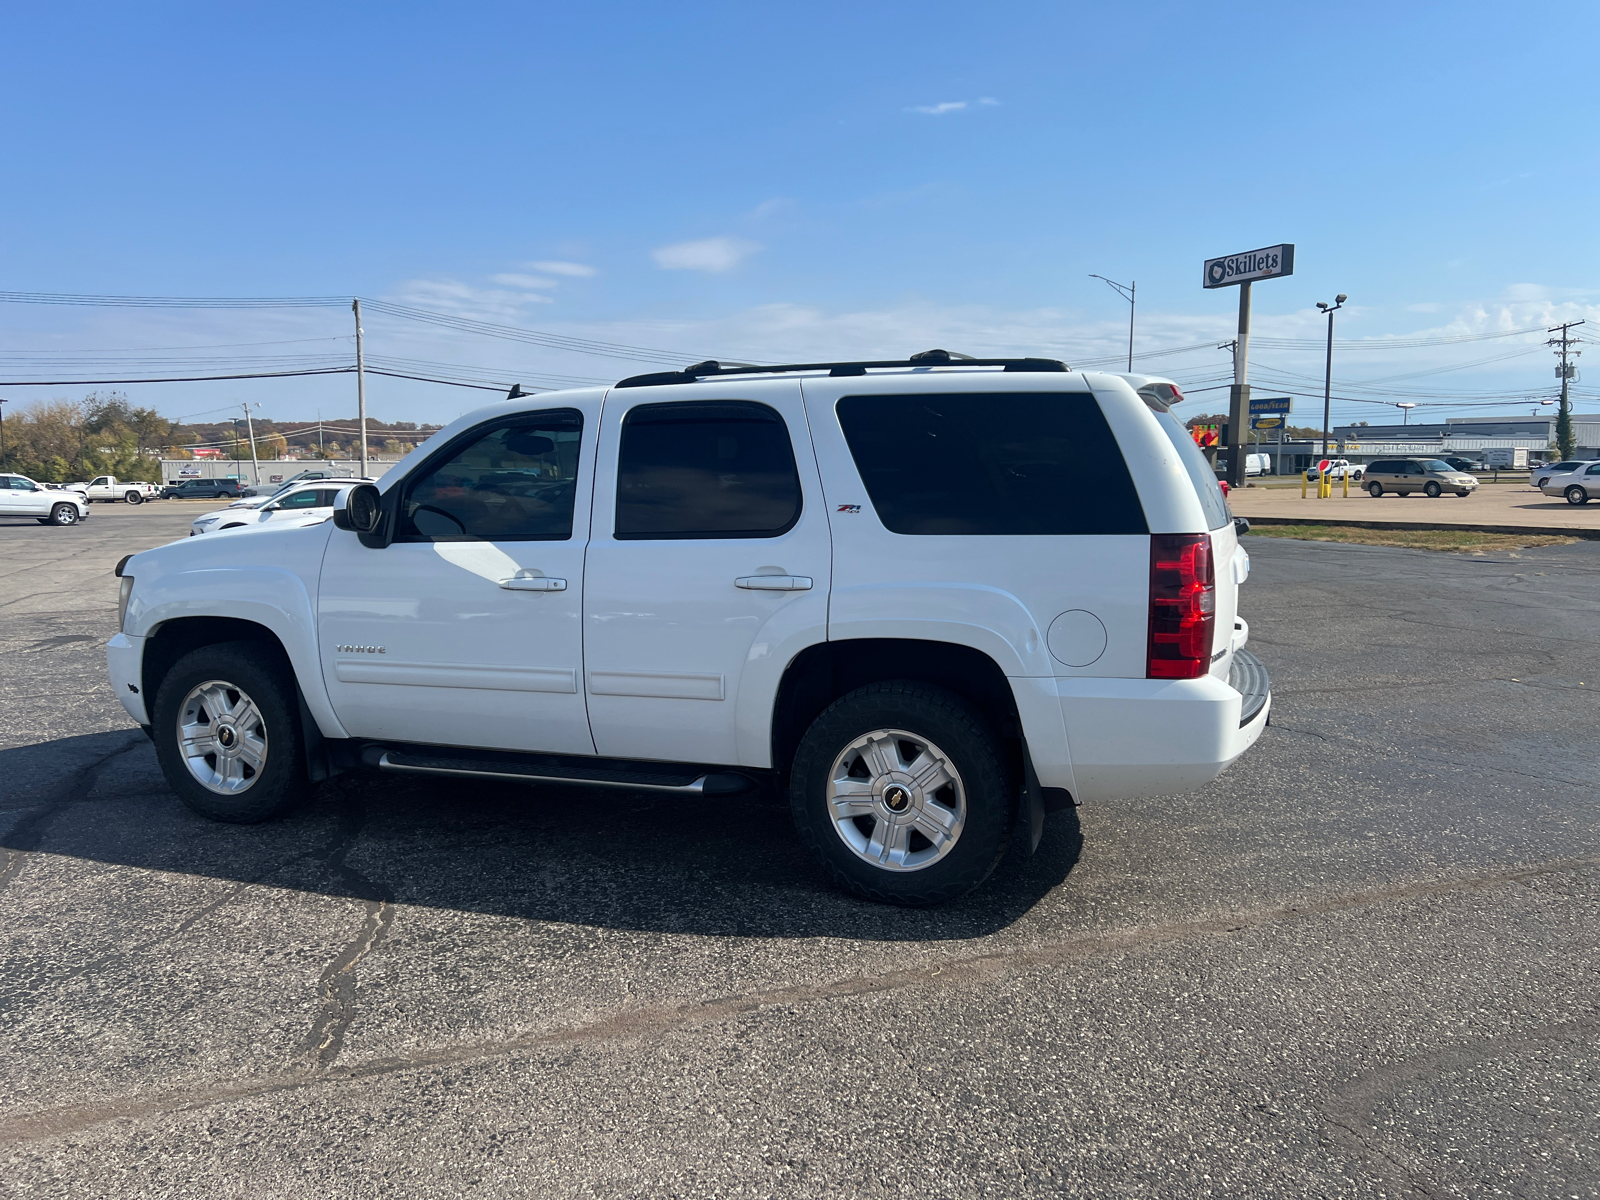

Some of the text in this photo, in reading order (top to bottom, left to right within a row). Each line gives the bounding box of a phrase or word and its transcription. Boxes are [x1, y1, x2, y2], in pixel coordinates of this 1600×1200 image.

[1226, 252, 1278, 277] Skillets
[1250, 401, 1289, 410] GOODYEAR
[335, 644, 386, 654] TAHOE
